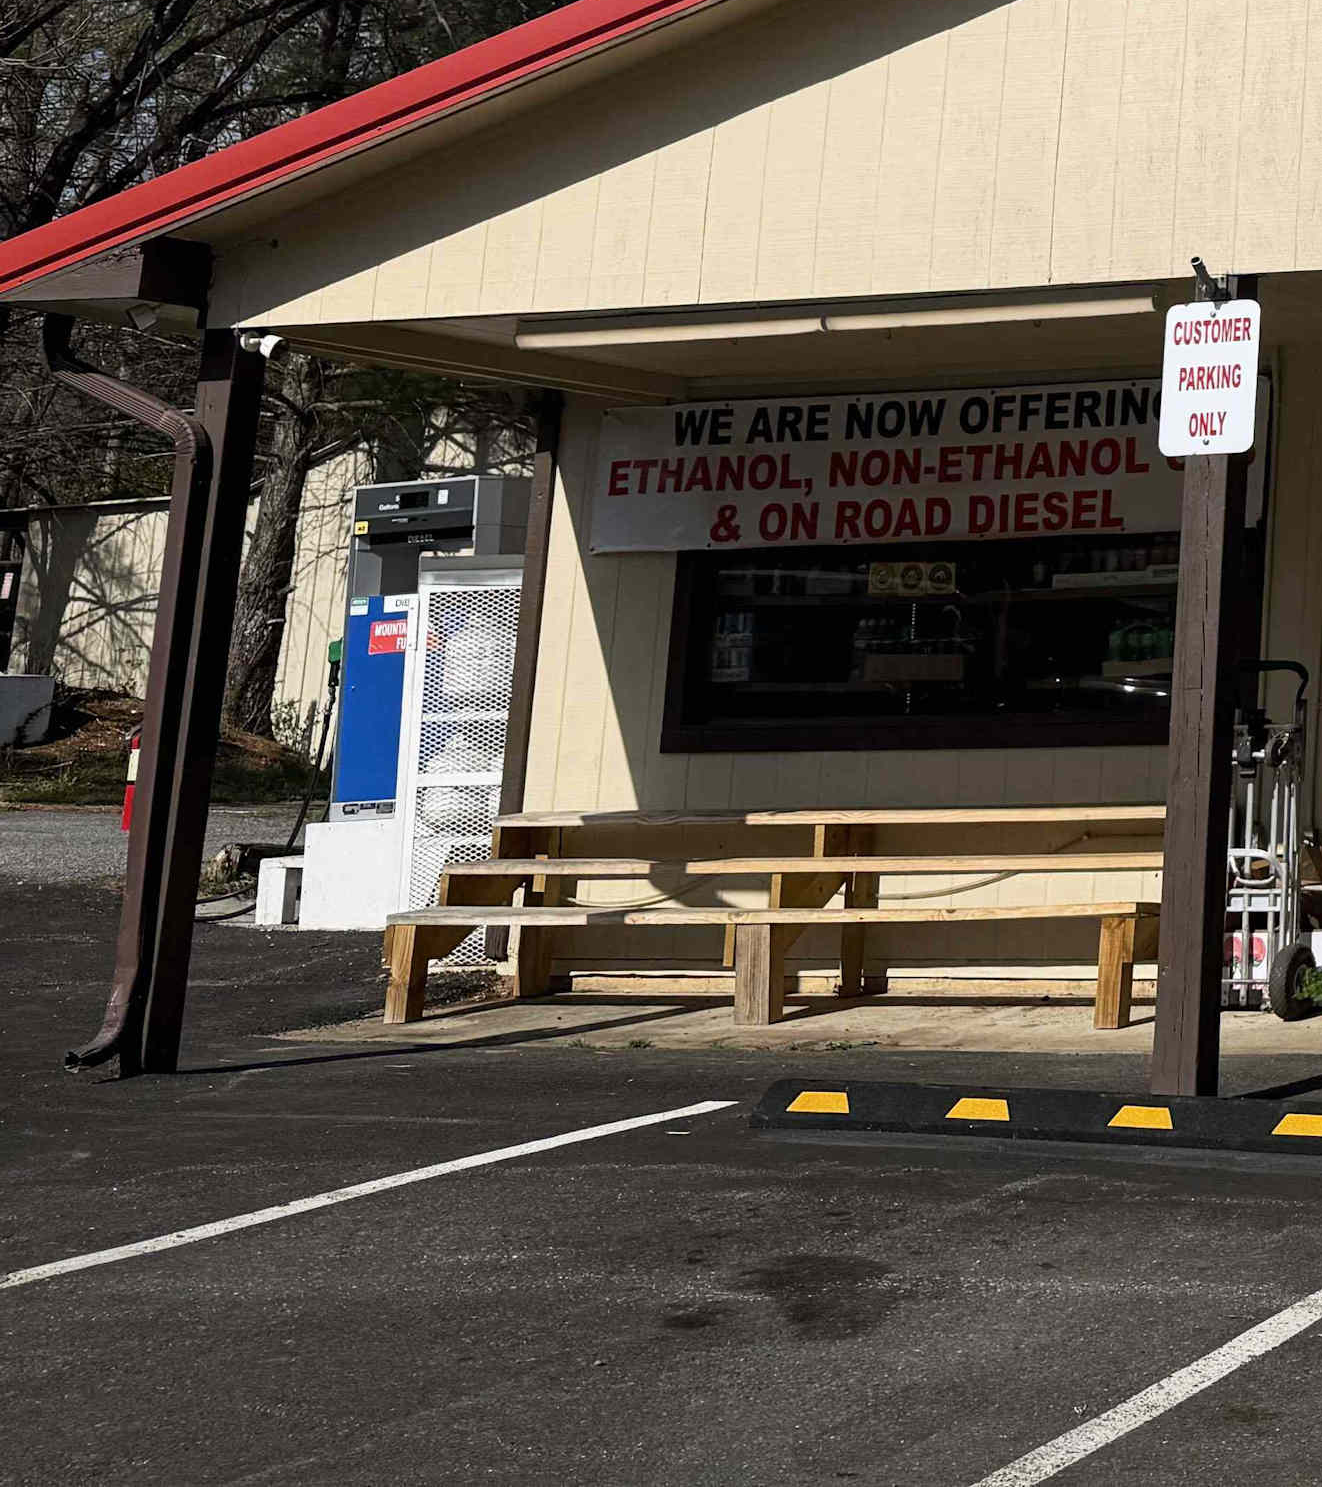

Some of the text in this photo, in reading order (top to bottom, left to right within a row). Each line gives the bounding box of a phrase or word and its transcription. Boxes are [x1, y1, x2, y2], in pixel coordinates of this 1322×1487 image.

[1173, 317, 1252, 345] CUSTOMER
[1179, 364, 1242, 391] PARKING
[675, 407, 733, 446] WE
[747, 402, 830, 444] ARE
[845, 399, 945, 440] NOW
[1189, 412, 1227, 437] ONLY
[608, 436, 1149, 497] ETHANOL, NON-ETHANOL
[709, 489, 1125, 543] & ON ROAD DIESEL
